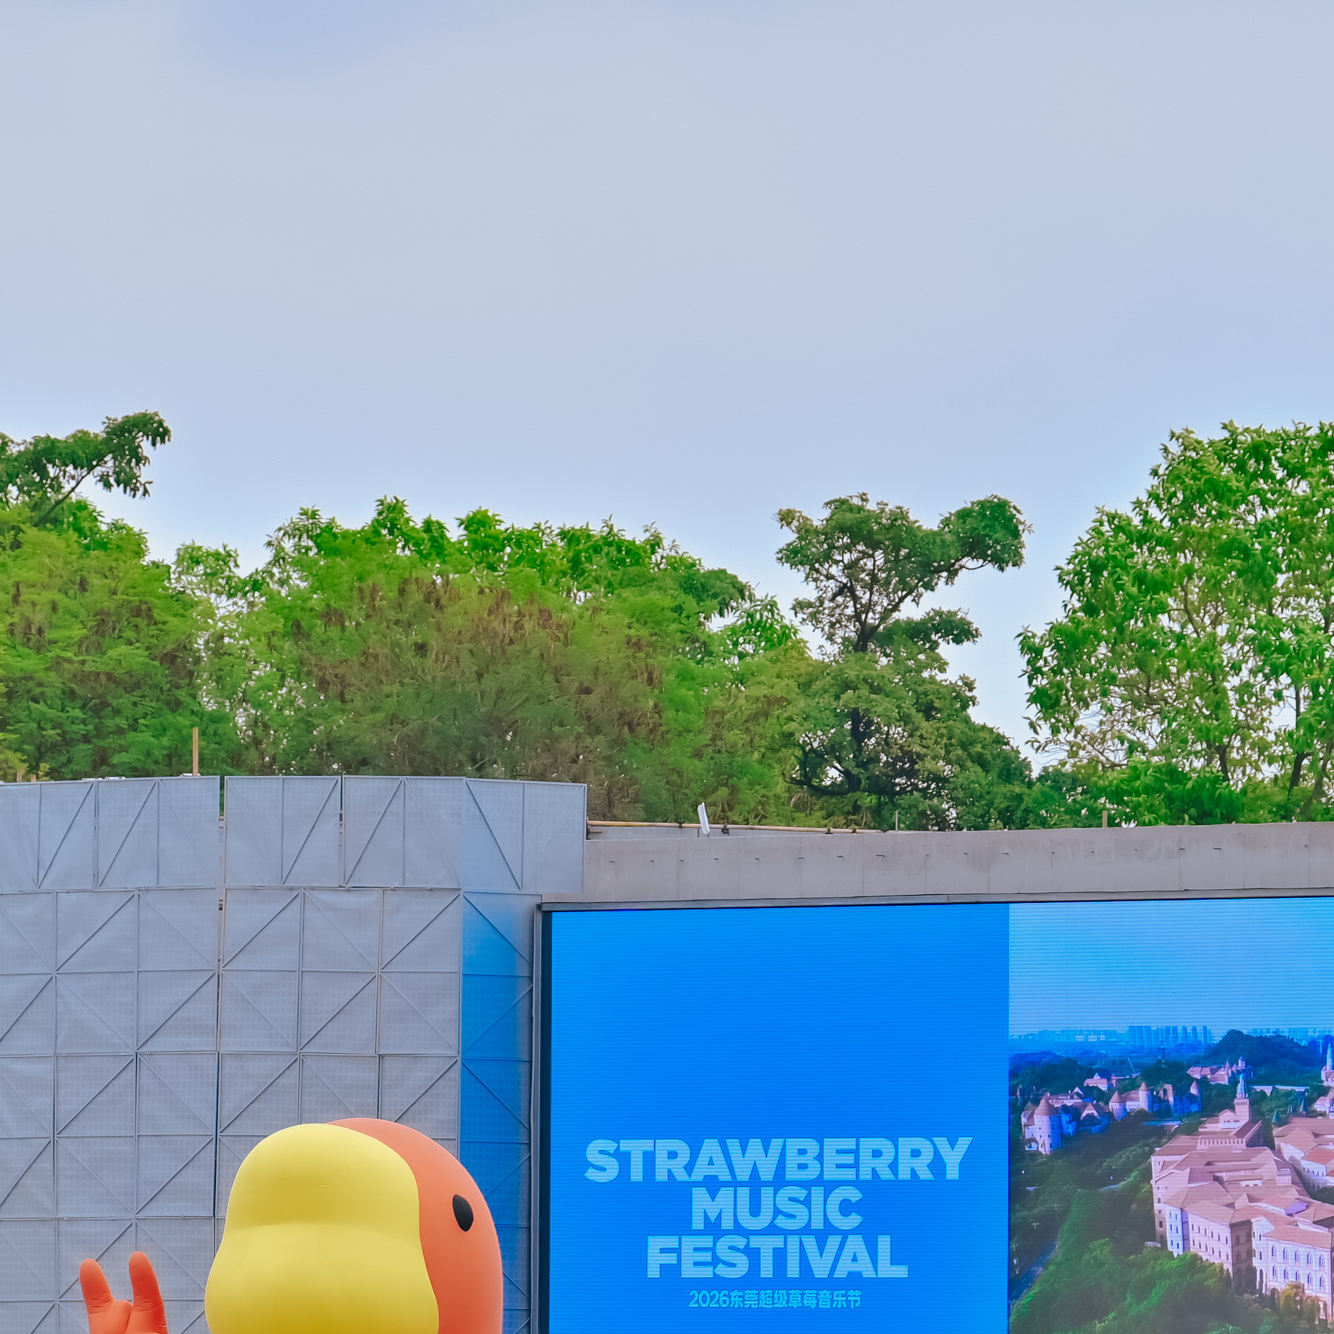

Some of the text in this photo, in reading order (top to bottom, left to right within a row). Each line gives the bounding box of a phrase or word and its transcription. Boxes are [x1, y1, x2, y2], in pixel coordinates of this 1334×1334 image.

[583, 1136, 974, 1183] STRAWBERRY
[691, 1185, 864, 1231] MUSIC
[646, 1234, 909, 1279] FESTIVAL
[688, 1289, 862, 1309] 2026东莞超级草莓音乐节
